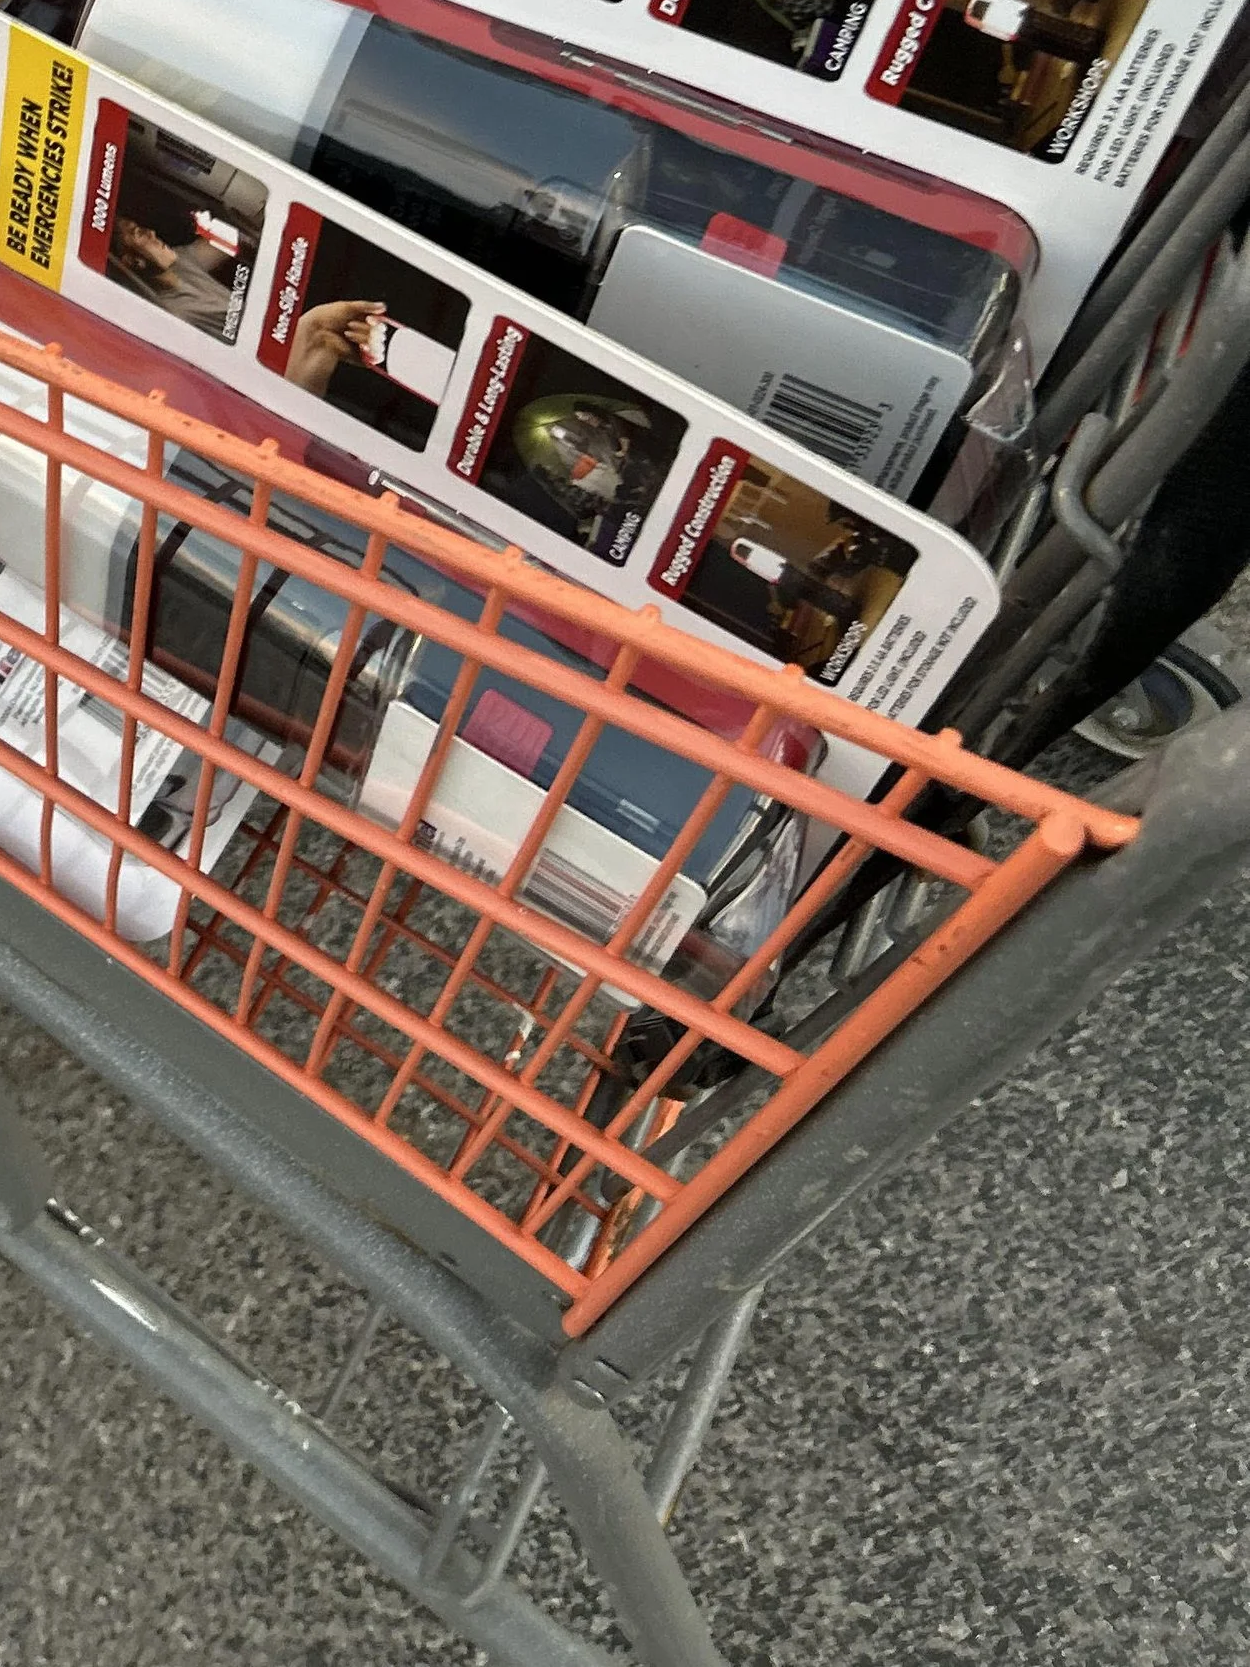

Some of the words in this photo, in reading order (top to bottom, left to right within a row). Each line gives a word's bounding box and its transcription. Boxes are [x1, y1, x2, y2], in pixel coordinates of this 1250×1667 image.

[823, 0, 869, 72] CAMPING
[879, 11, 928, 86] Rugged
[16, 97, 42, 160] WHEN
[47, 60, 73, 138] STRIKE!
[1045, 55, 1111, 157] WORKSHOPS
[8, 159, 36, 228] READY
[29, 137, 66, 268] EMERGENCIES
[97, 142, 118, 200] Lumens
[6, 226, 27, 255] BE
[91, 198, 110, 232] 1000
[222, 262, 249, 340] EMERGENCIES
[271, 283, 299, 344] Non-Slip
[285, 233, 308, 286] Handle
[477, 324, 523, 414] Long-Lasting
[456, 421, 486, 476] Durable
[473, 408, 490, 426] &
[608, 508, 640, 563] CAMPING
[659, 533, 696, 588] Rugged
[683, 451, 736, 539] Construction
[819, 615, 867, 684] WORKSHOPS
